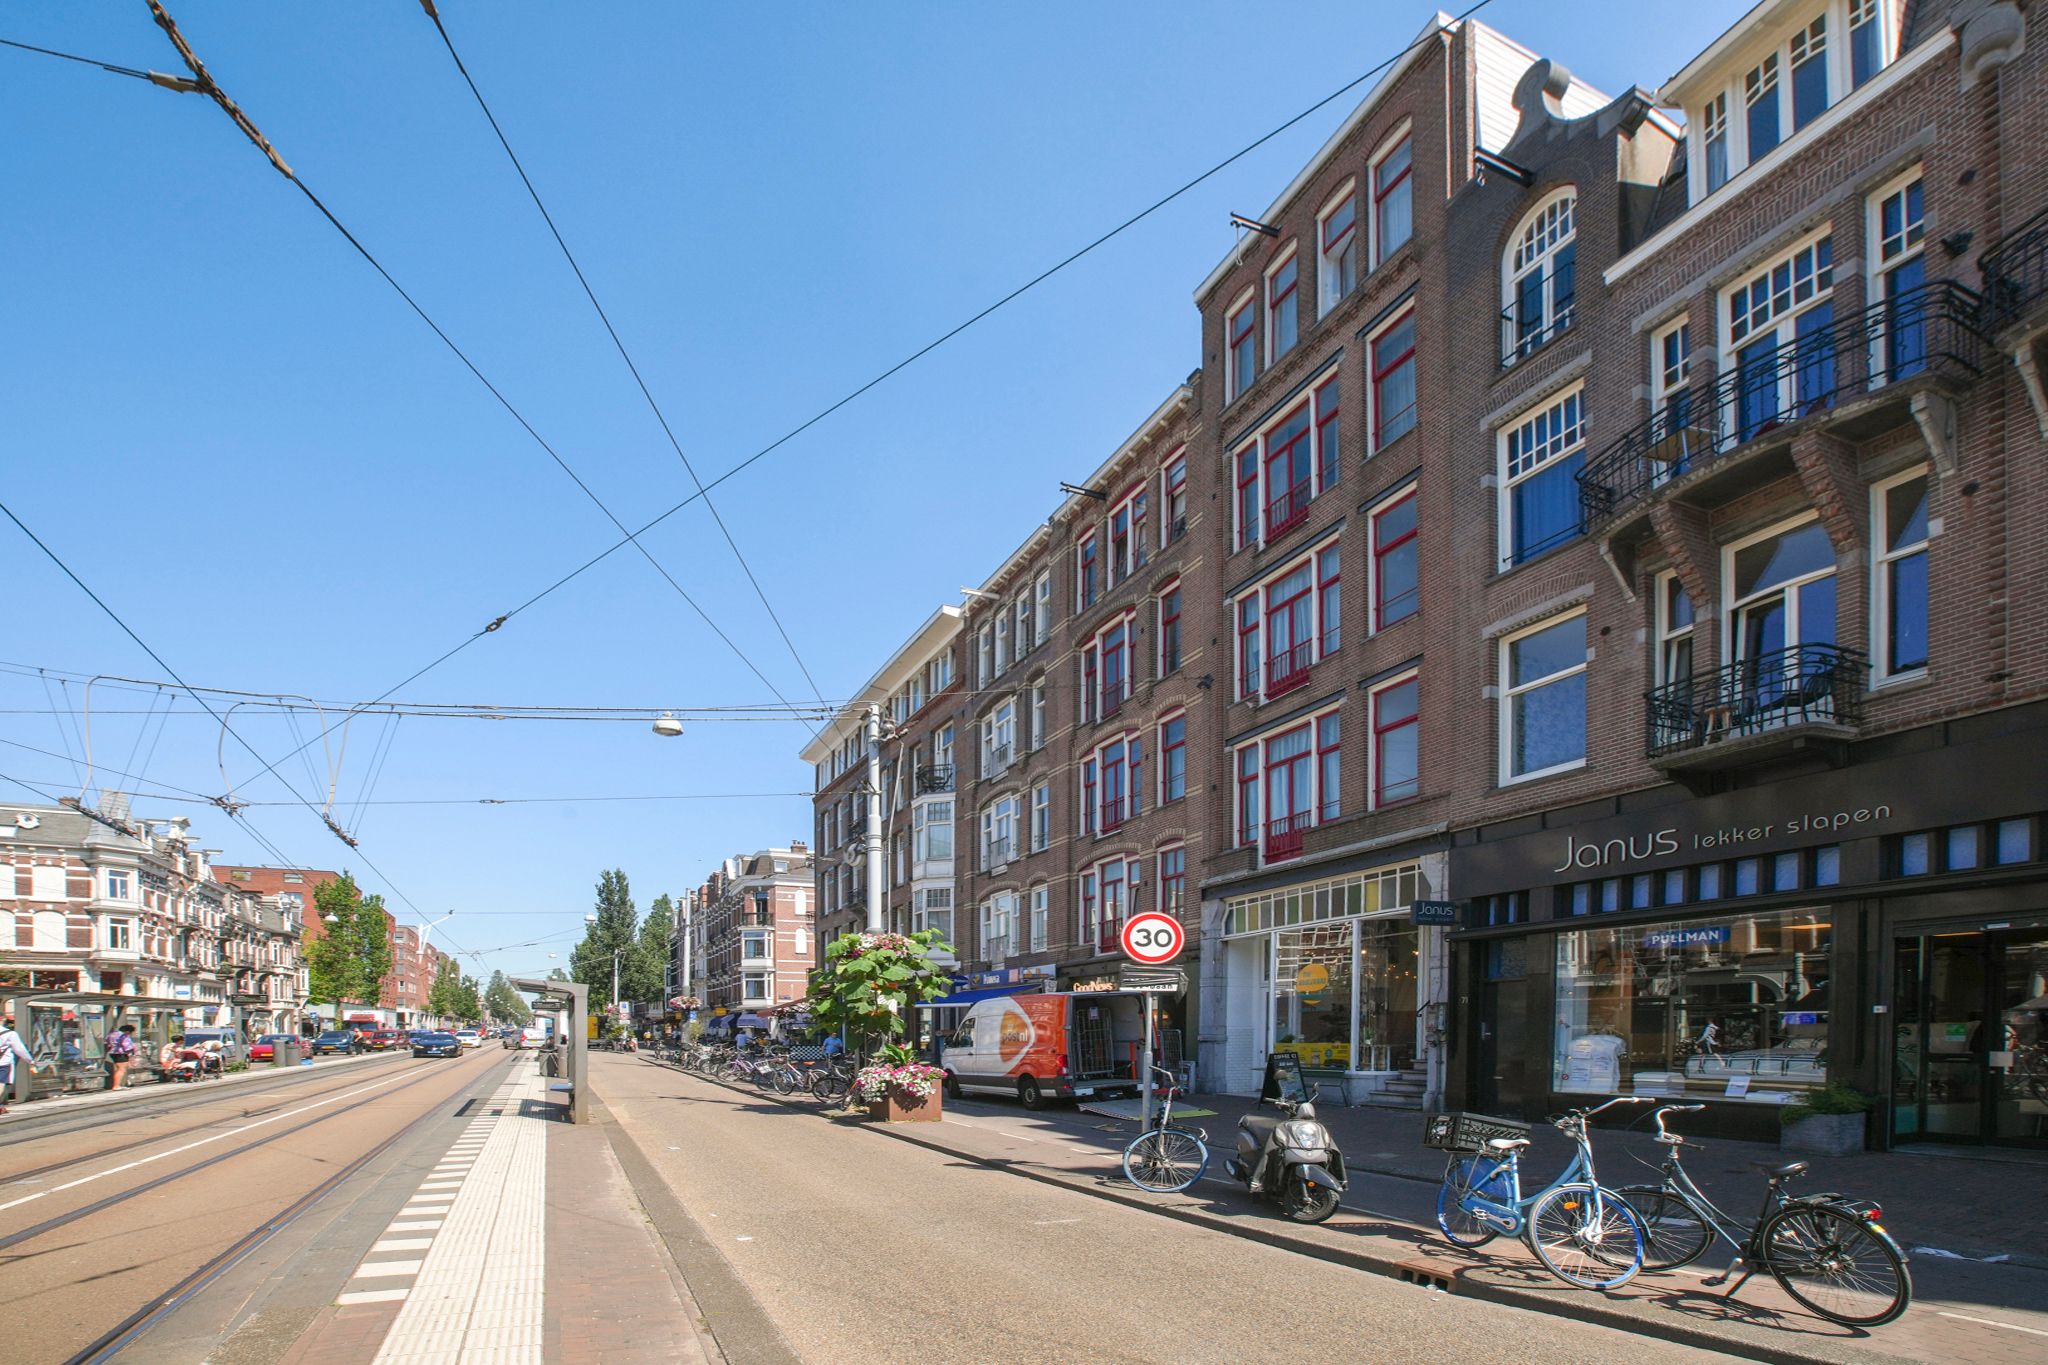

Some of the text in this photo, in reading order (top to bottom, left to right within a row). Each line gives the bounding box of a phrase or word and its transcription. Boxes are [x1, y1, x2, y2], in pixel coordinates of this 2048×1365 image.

[1554, 805, 1891, 873] Janus lekker slapen
[1418, 902, 1454, 916] Janus
[1134, 928, 1173, 948] 30
[1651, 930, 1719, 944] PULLMAN
